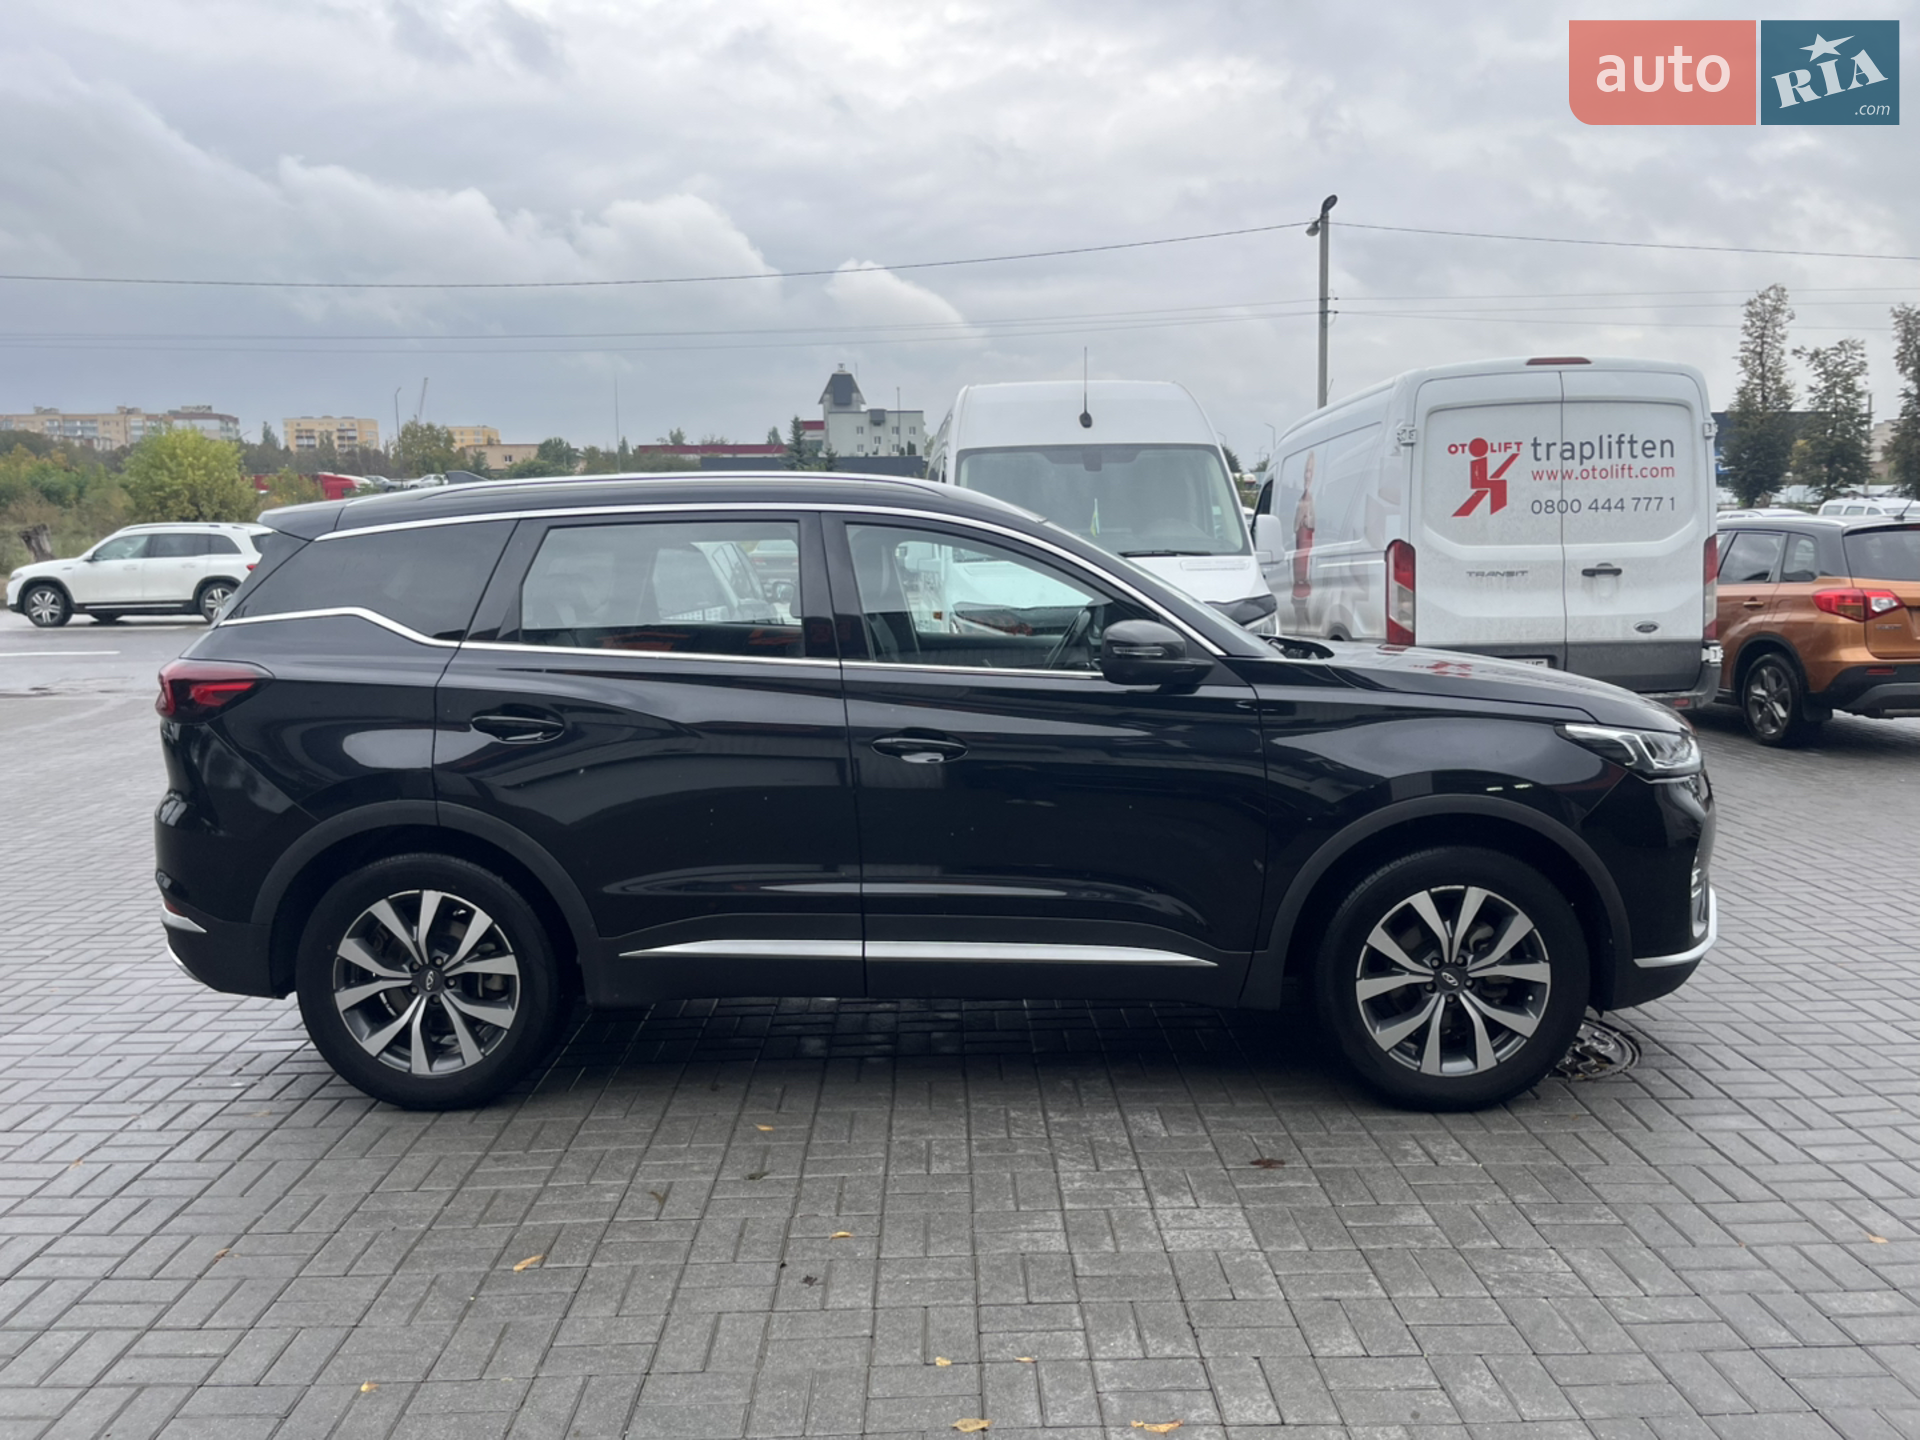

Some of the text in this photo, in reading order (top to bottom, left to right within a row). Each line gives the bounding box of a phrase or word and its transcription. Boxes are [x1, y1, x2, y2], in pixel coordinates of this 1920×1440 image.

[1530, 433, 1675, 466] trapliften
[1531, 463, 1675, 481] www.otolift.com
[1531, 498, 1582, 515] 0800
[1587, 497, 1625, 513] 444
